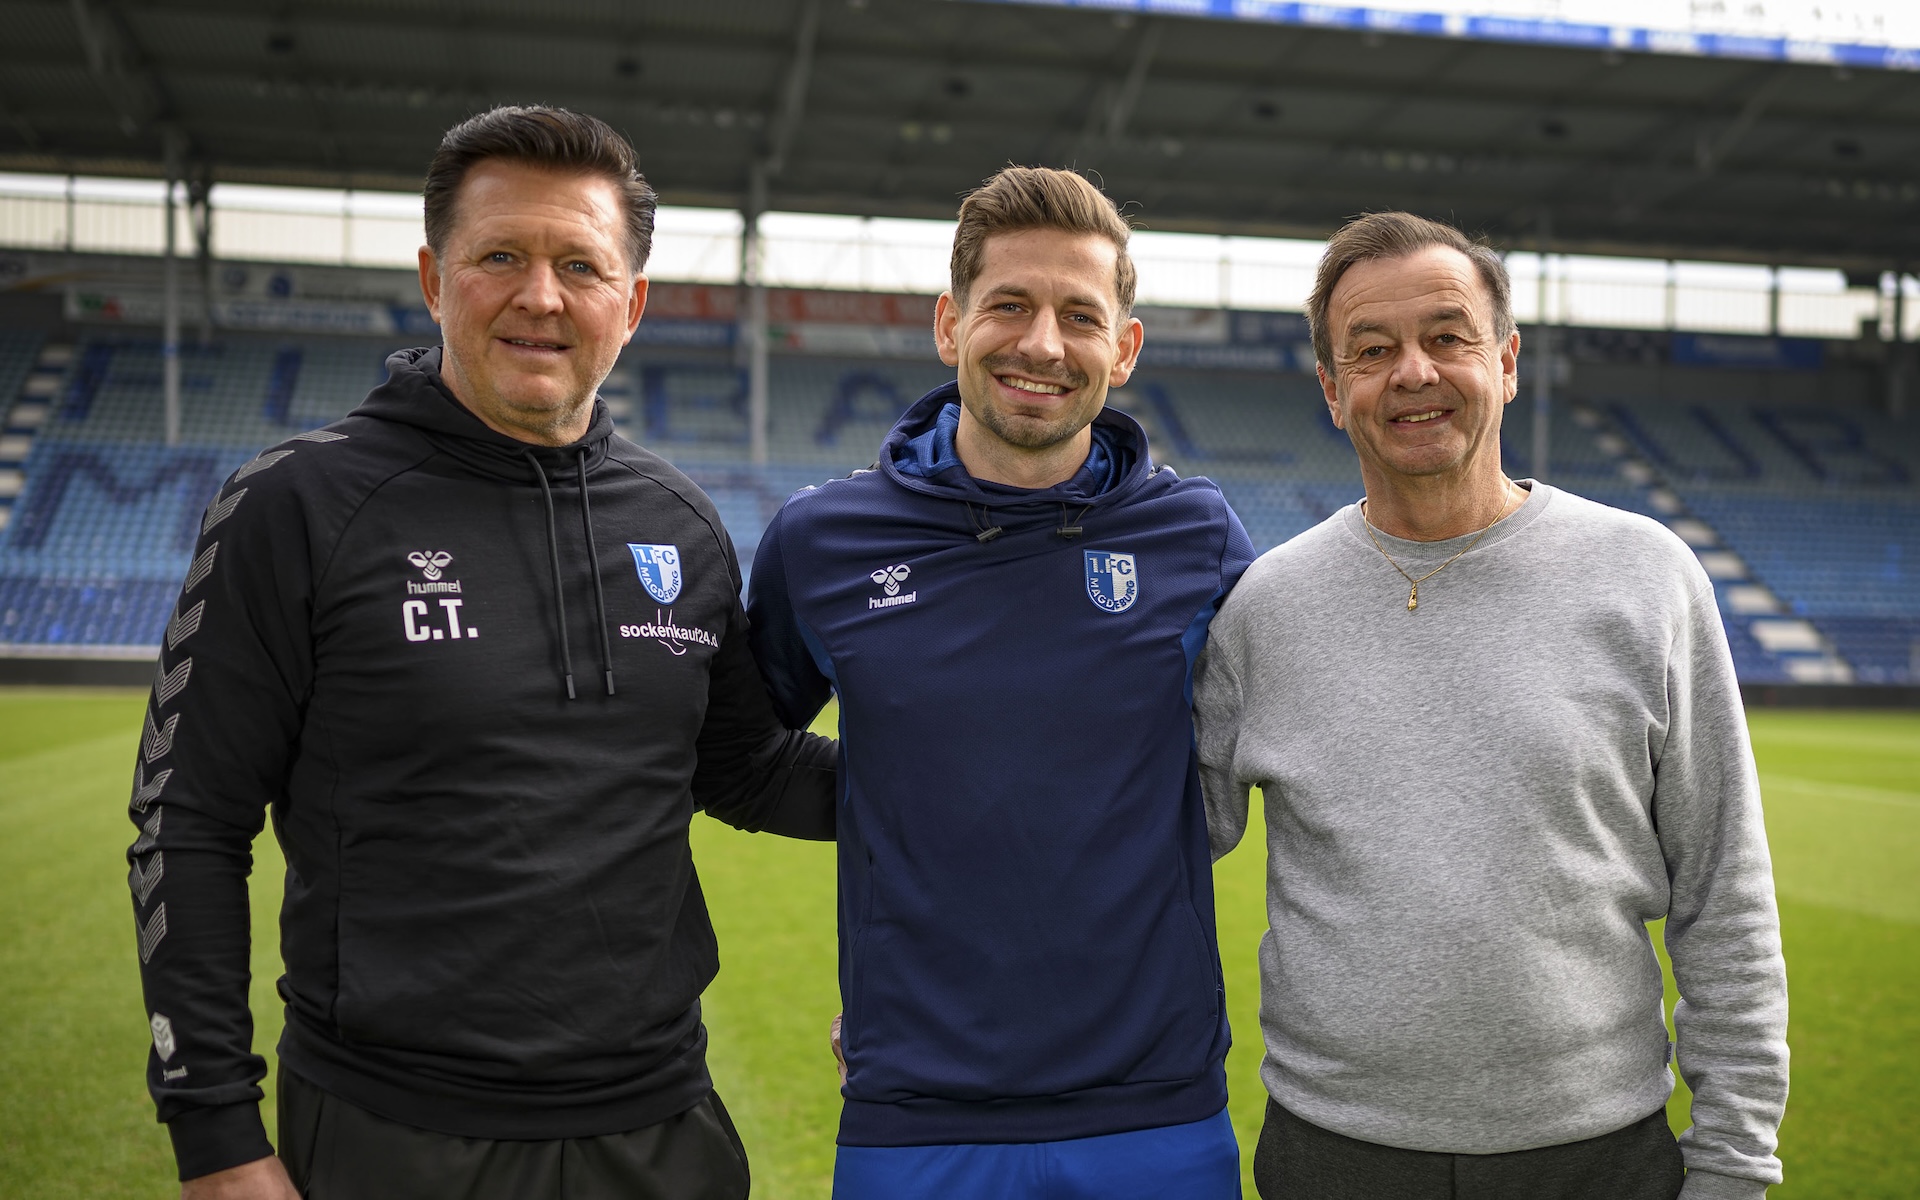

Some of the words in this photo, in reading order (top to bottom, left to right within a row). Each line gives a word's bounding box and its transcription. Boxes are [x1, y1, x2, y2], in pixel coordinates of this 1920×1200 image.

[407, 579, 461, 595] hummel
[640, 566, 679, 600] MAGDEBURG
[1090, 577, 1135, 610] MAGDEBURG
[868, 590, 917, 610] hummel
[402, 599, 479, 642] C.T.
